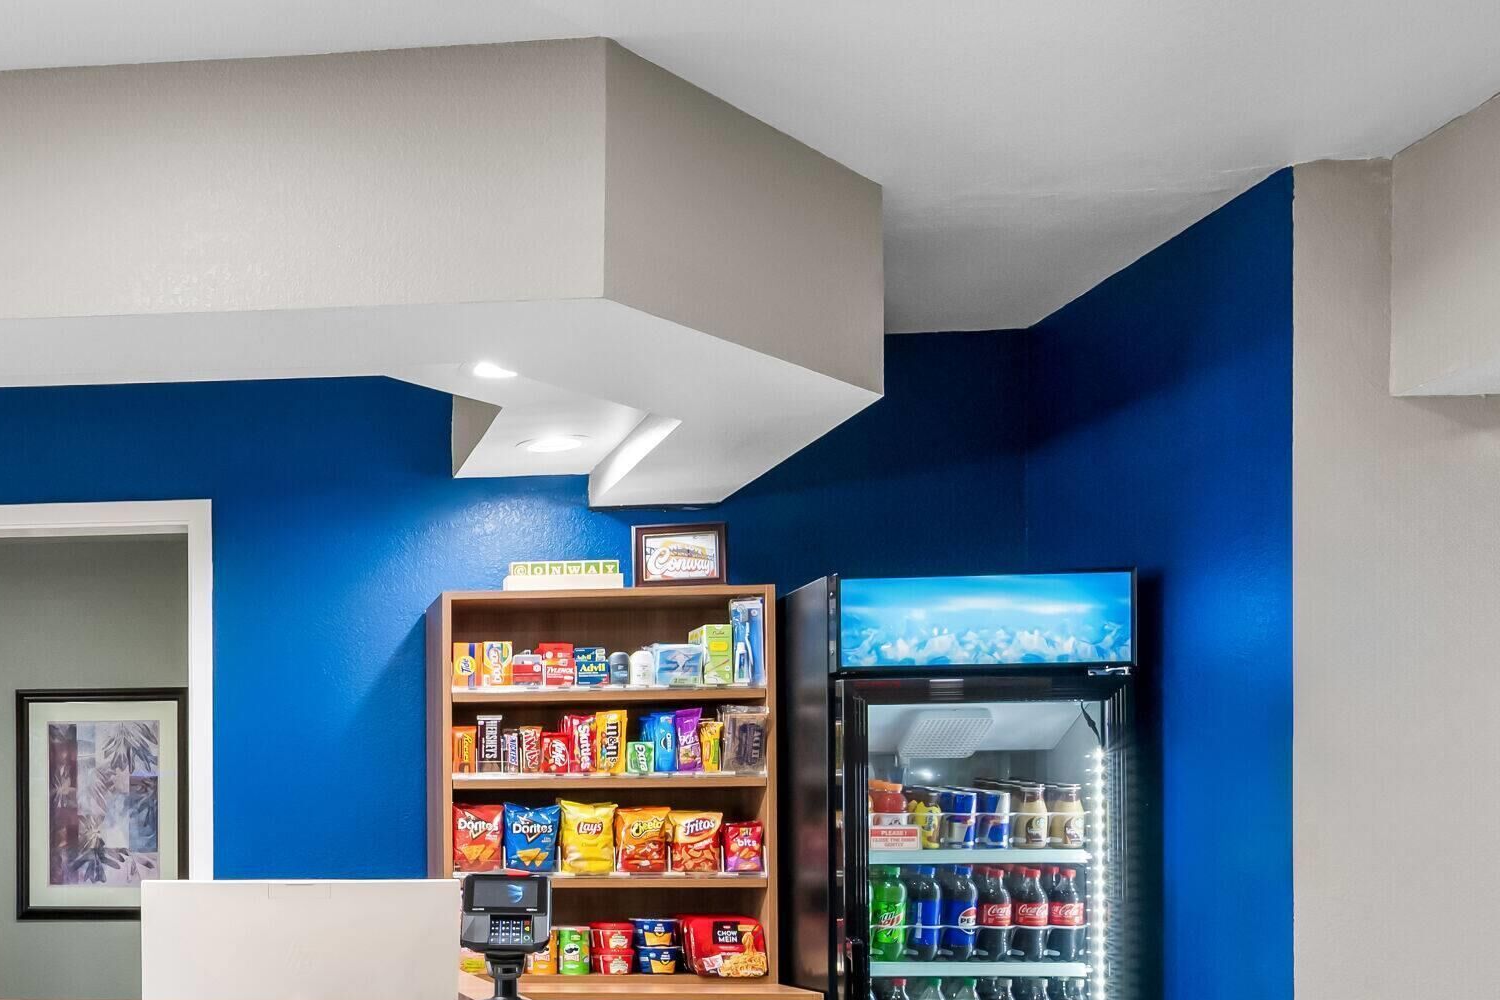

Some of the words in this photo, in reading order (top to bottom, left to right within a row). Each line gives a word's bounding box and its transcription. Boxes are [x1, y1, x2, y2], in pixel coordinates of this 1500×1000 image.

[460, 658, 472, 673] Tide
[580, 662, 606, 672] Advil
[578, 724, 592, 769] Skittles
[458, 819, 499, 831] Doritos
[512, 823, 552, 834] Doritos
[684, 818, 716, 836] Fritos
